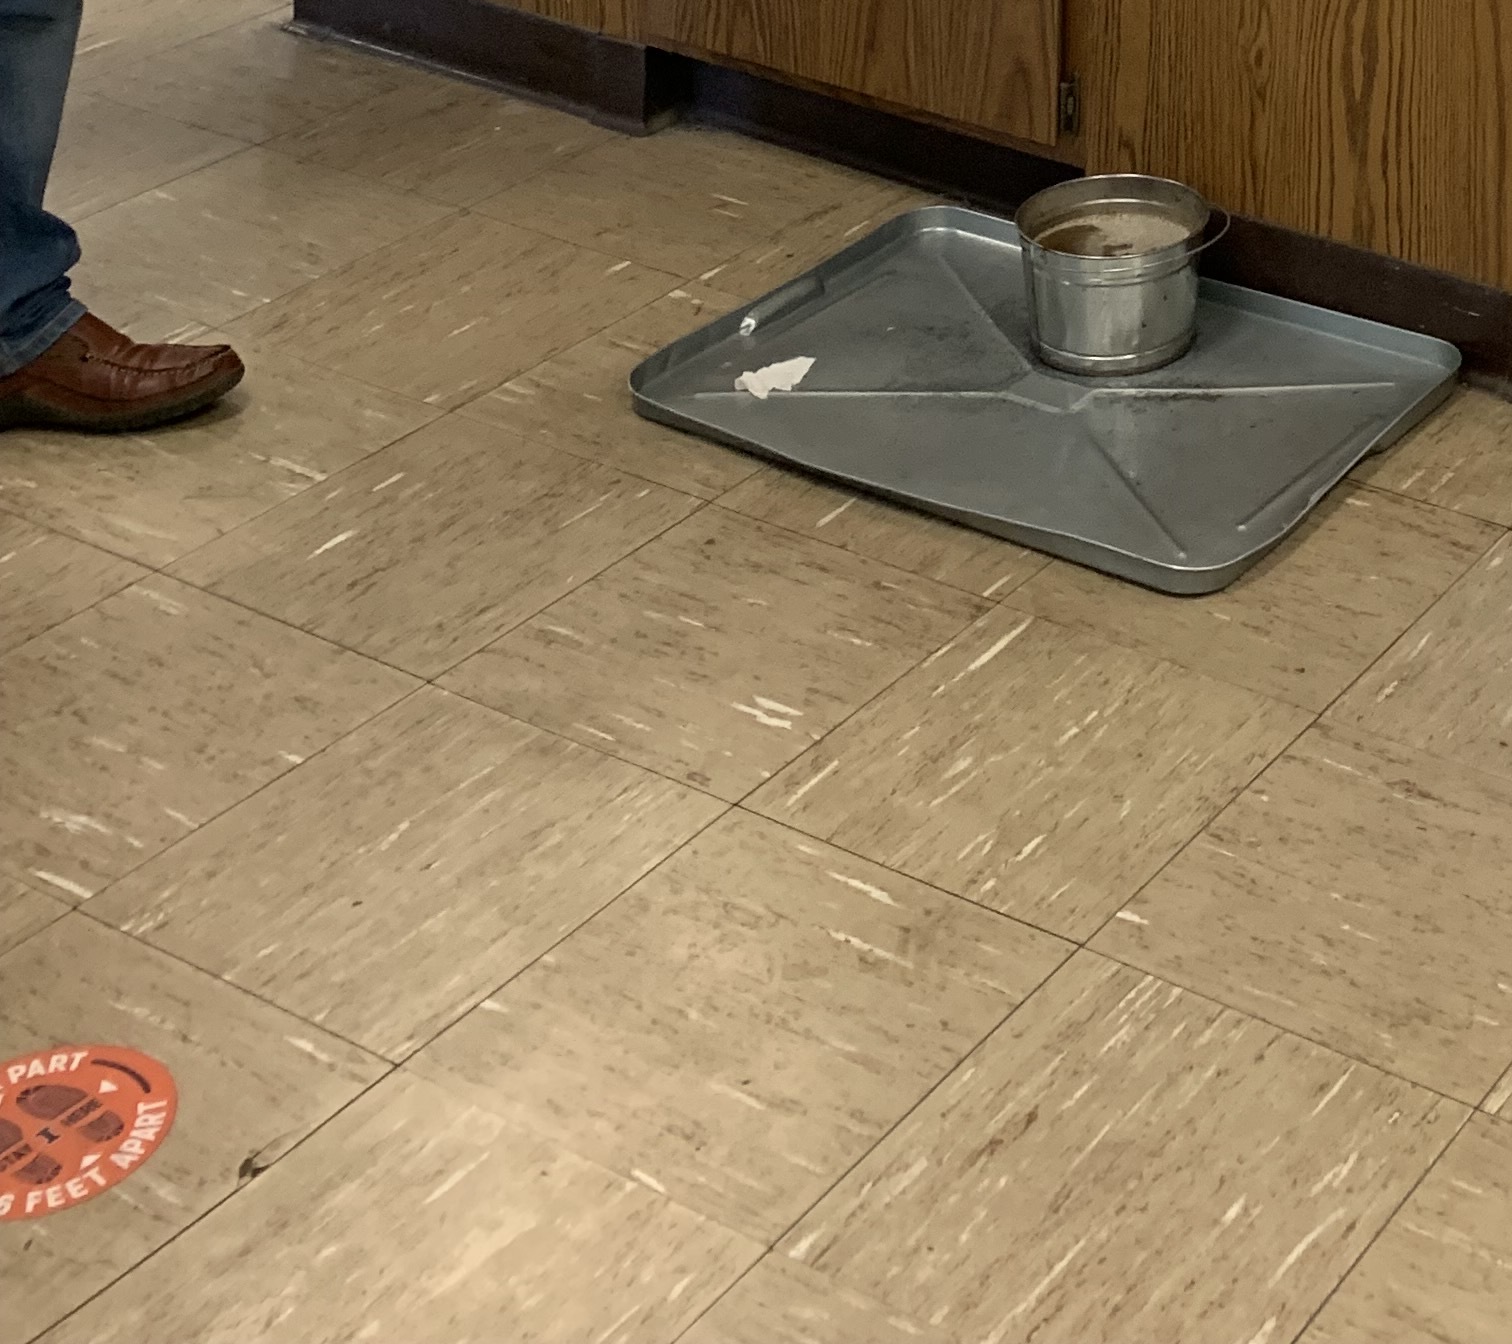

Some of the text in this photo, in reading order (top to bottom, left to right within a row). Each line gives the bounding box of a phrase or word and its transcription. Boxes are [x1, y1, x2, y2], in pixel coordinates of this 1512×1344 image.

[7, 1050, 90, 1085] PART
[25, 1166, 107, 1214] FEET
[109, 1099, 169, 1171] APART
